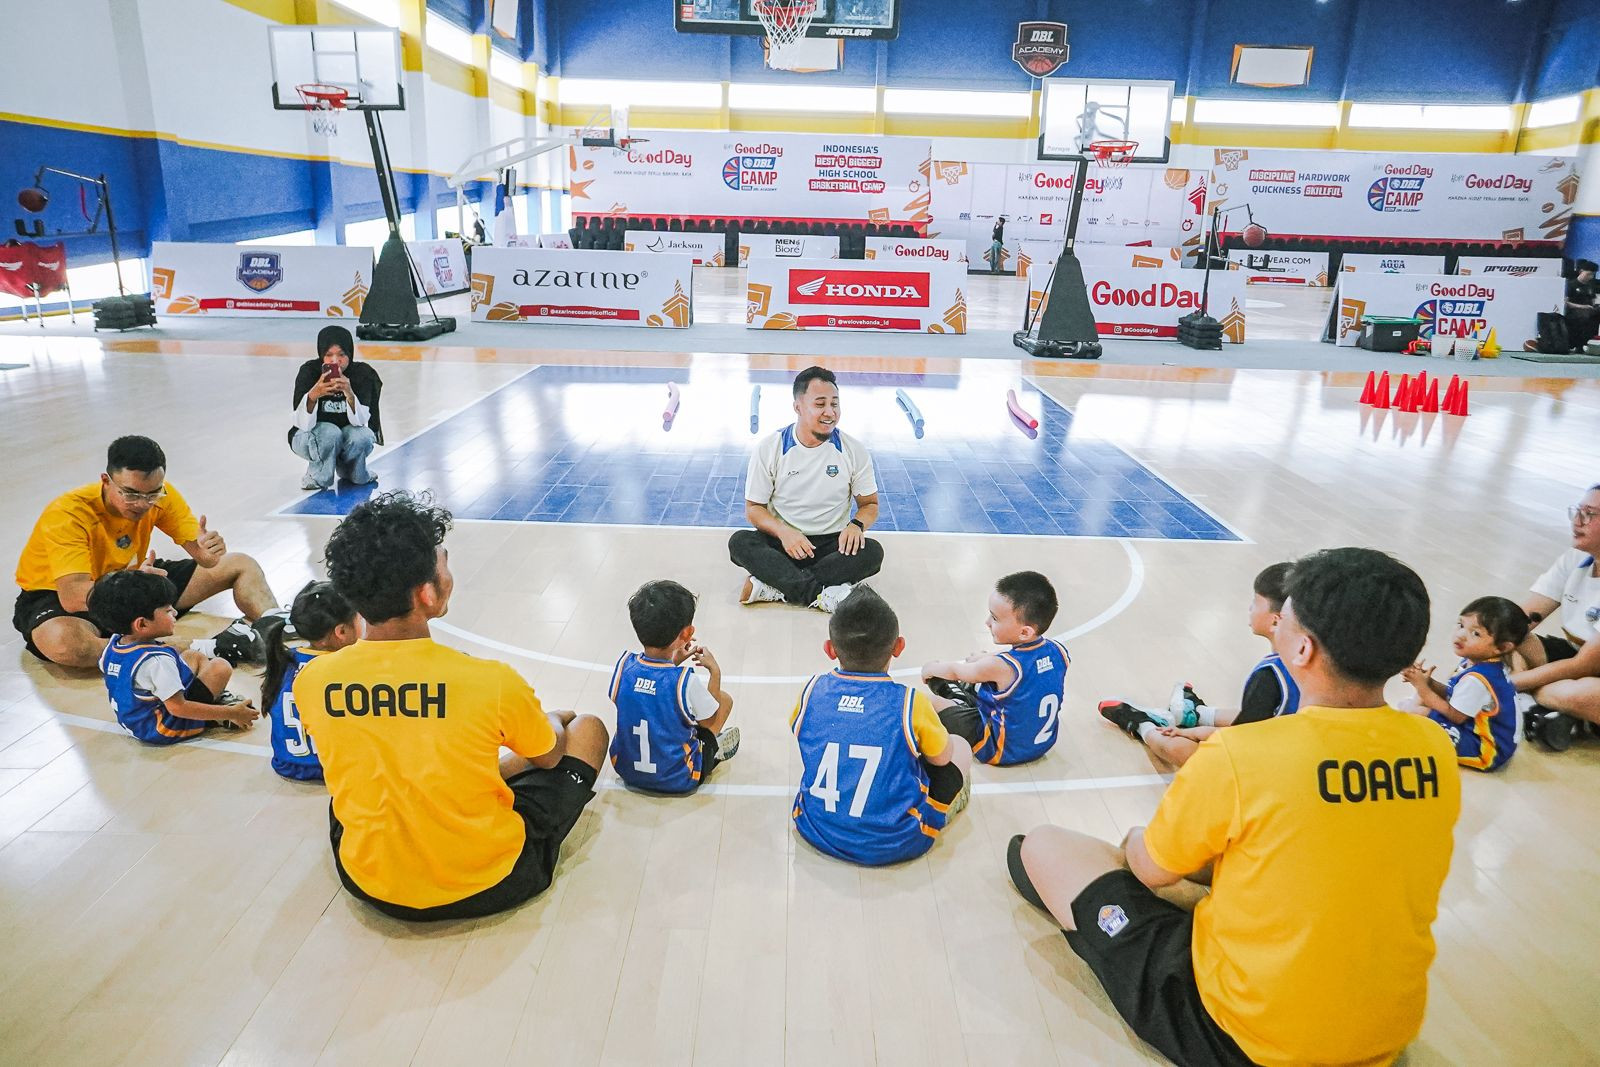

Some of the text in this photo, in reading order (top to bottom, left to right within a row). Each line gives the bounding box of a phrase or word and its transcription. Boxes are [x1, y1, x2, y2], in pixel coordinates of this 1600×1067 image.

[1030, 30, 1054, 42] DBL
[1019, 46, 1064, 55] ACADEMY
[735, 143, 762, 154] Good
[763, 144, 784, 157] Day
[823, 144, 879, 154] INDONESIA'S
[665, 150, 692, 168] Day
[752, 159, 773, 168] DBL
[816, 156, 836, 166] BEST
[849, 157, 881, 167] BIGGEST
[819, 169, 878, 179] HIGH SCHOOL
[1250, 171, 1351, 182] DISCIPLINE HARDWORK
[1385, 163, 1412, 175] Good
[1413, 164, 1434, 178] Day
[741, 171, 778, 185] CAMP
[1034, 172, 1073, 189] Good
[1400, 179, 1420, 189] DBL
[1465, 173, 1503, 189] Good
[1504, 174, 1533, 193] Day
[810, 180, 884, 191] BASKETBALL CAMP
[1252, 185, 1342, 196] QUICKNESS SKILLFUL
[1385, 192, 1424, 206] CAMP
[668, 240, 703, 249] Jackson
[775, 244, 800, 253] Bioré
[895, 245, 925, 257] Good
[927, 246, 949, 260] Day
[250, 257, 271, 267] DBL
[1380, 259, 1405, 269] AQUA
[1483, 264, 1539, 273] proteam
[825, 284, 921, 298] HONDA
[1092, 280, 1208, 315] Good Day
[1430, 283, 1466, 297] Good
[1467, 284, 1495, 301] Day
[550, 309, 618, 317] @azarinecosmeticofficial
[1453, 304, 1480, 314] DBL
[1036, 656, 1053, 670] DBL
[634, 677, 657, 692] DBL
[324, 683, 446, 718] COACH
[838, 695, 864, 709] DBL
[1034, 694, 1059, 745] 2
[633, 719, 657, 774] 1
[809, 742, 883, 818] 47
[1317, 756, 1439, 803] COACH
